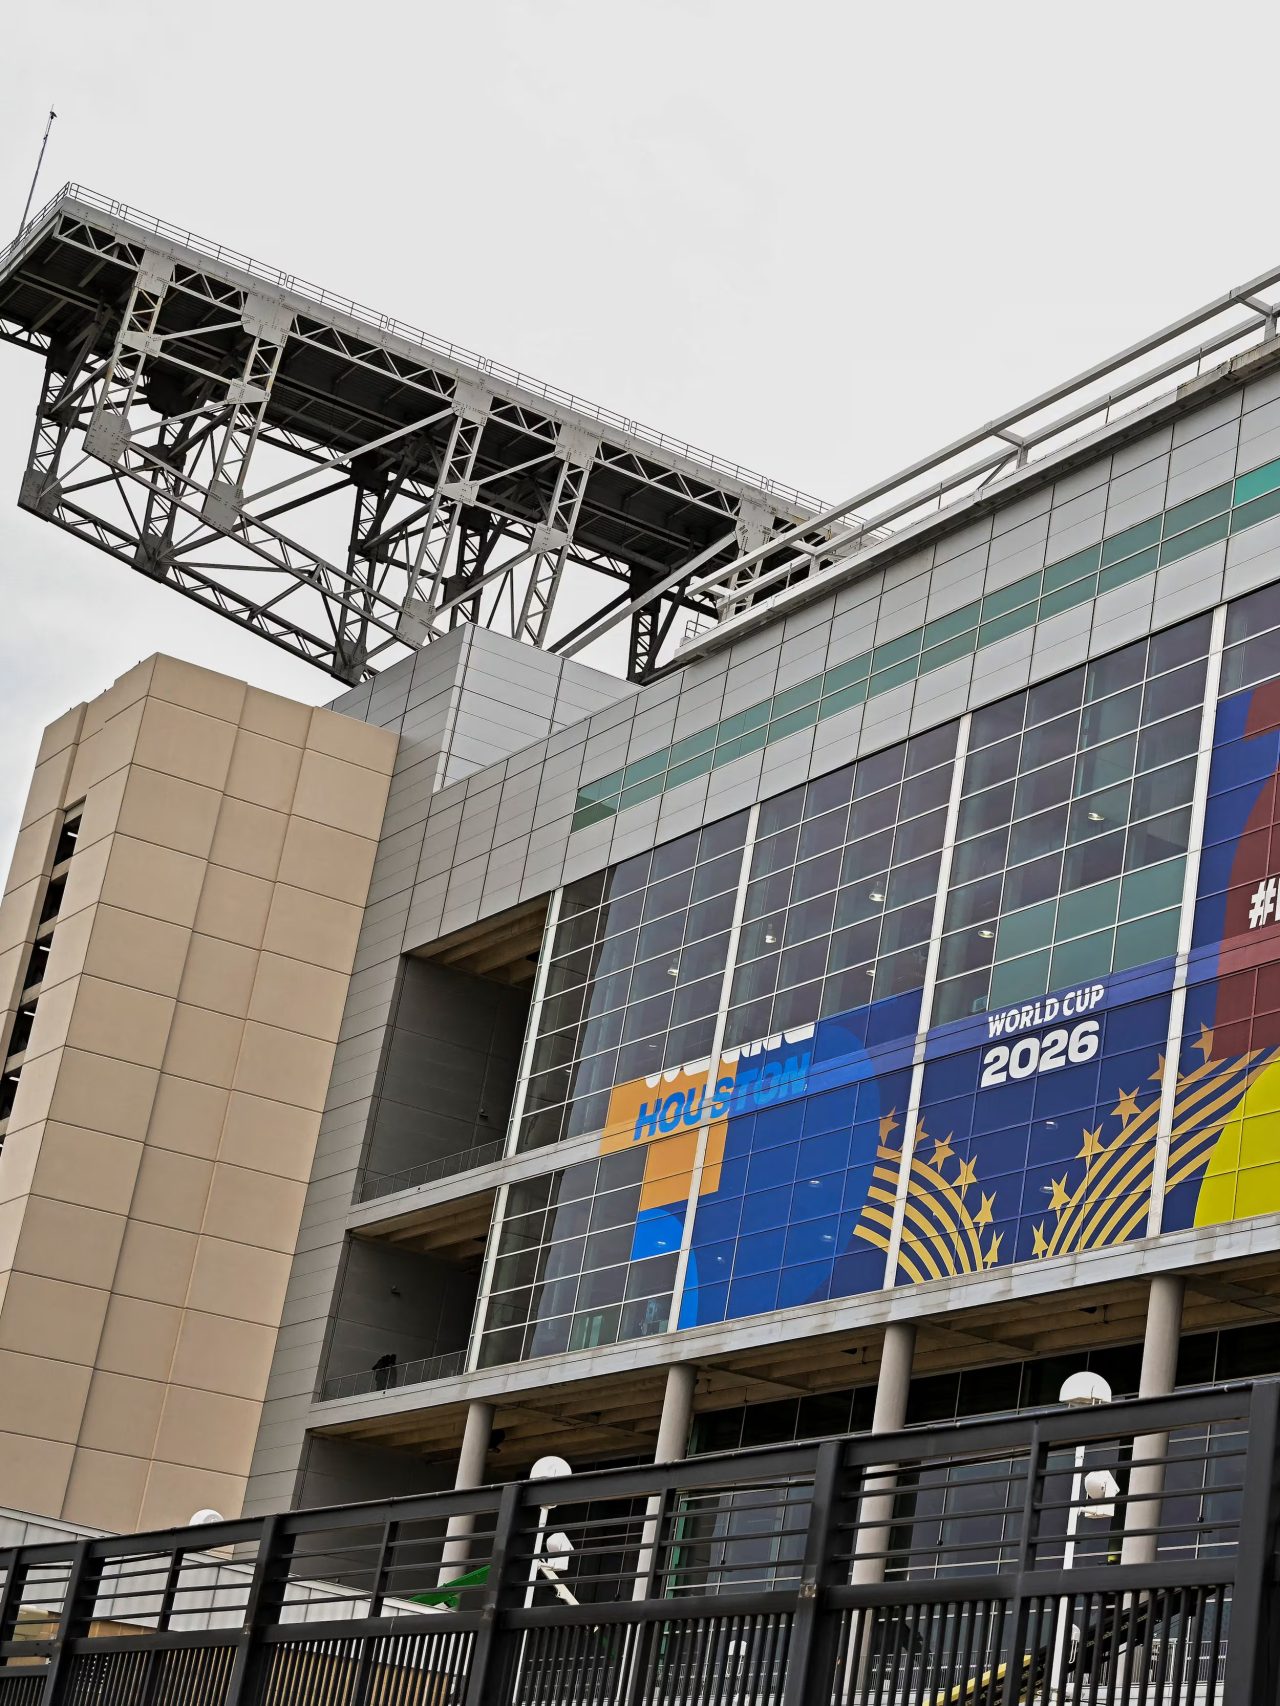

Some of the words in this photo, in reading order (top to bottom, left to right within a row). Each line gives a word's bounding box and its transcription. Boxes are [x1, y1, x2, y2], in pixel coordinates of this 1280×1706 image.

[988, 997, 1059, 1038] WORLD
[1063, 984, 1104, 1016] CUP
[981, 1020, 1100, 1088] 2026
[633, 1052, 812, 1141] HOUSTON
